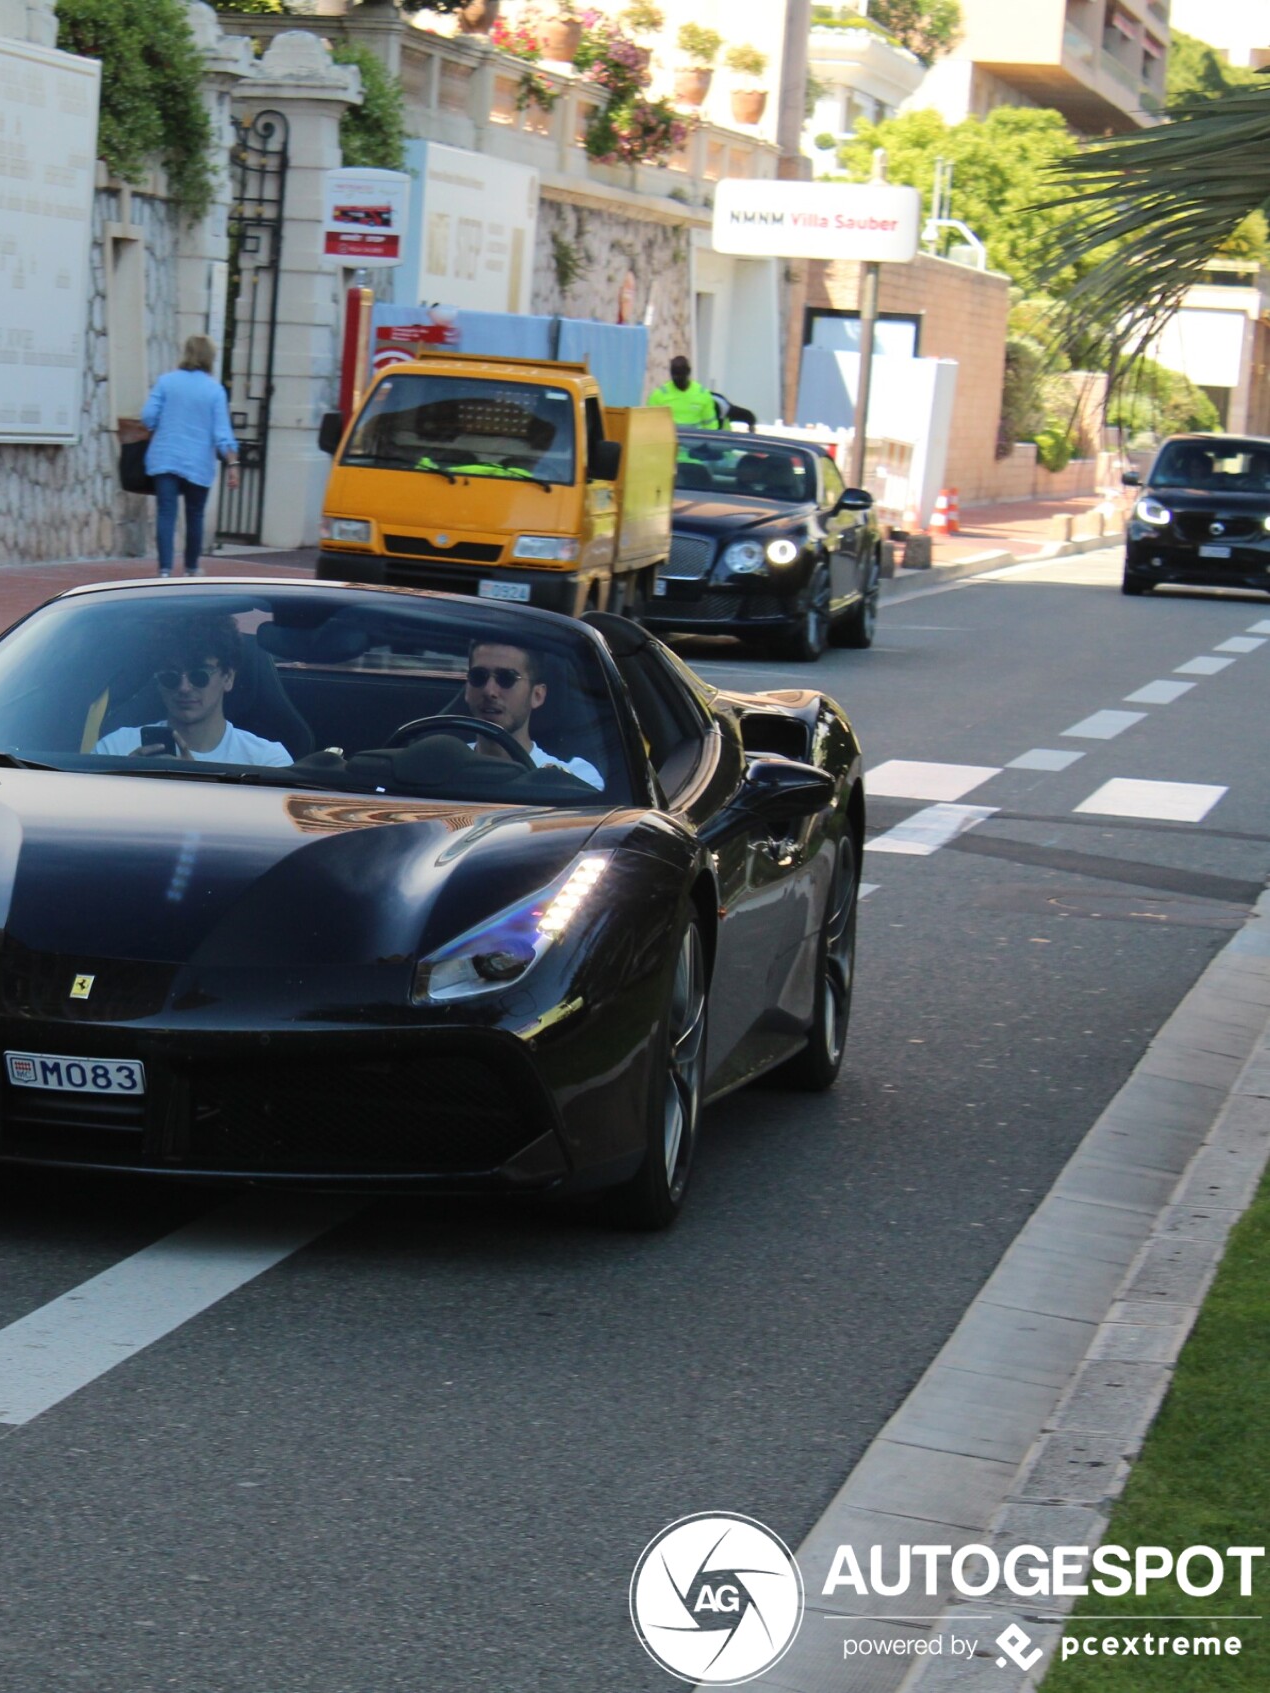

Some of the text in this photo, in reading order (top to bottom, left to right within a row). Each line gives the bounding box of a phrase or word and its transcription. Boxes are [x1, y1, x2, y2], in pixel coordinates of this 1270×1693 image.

[730, 210, 899, 231] NMNM Villa Sauber
